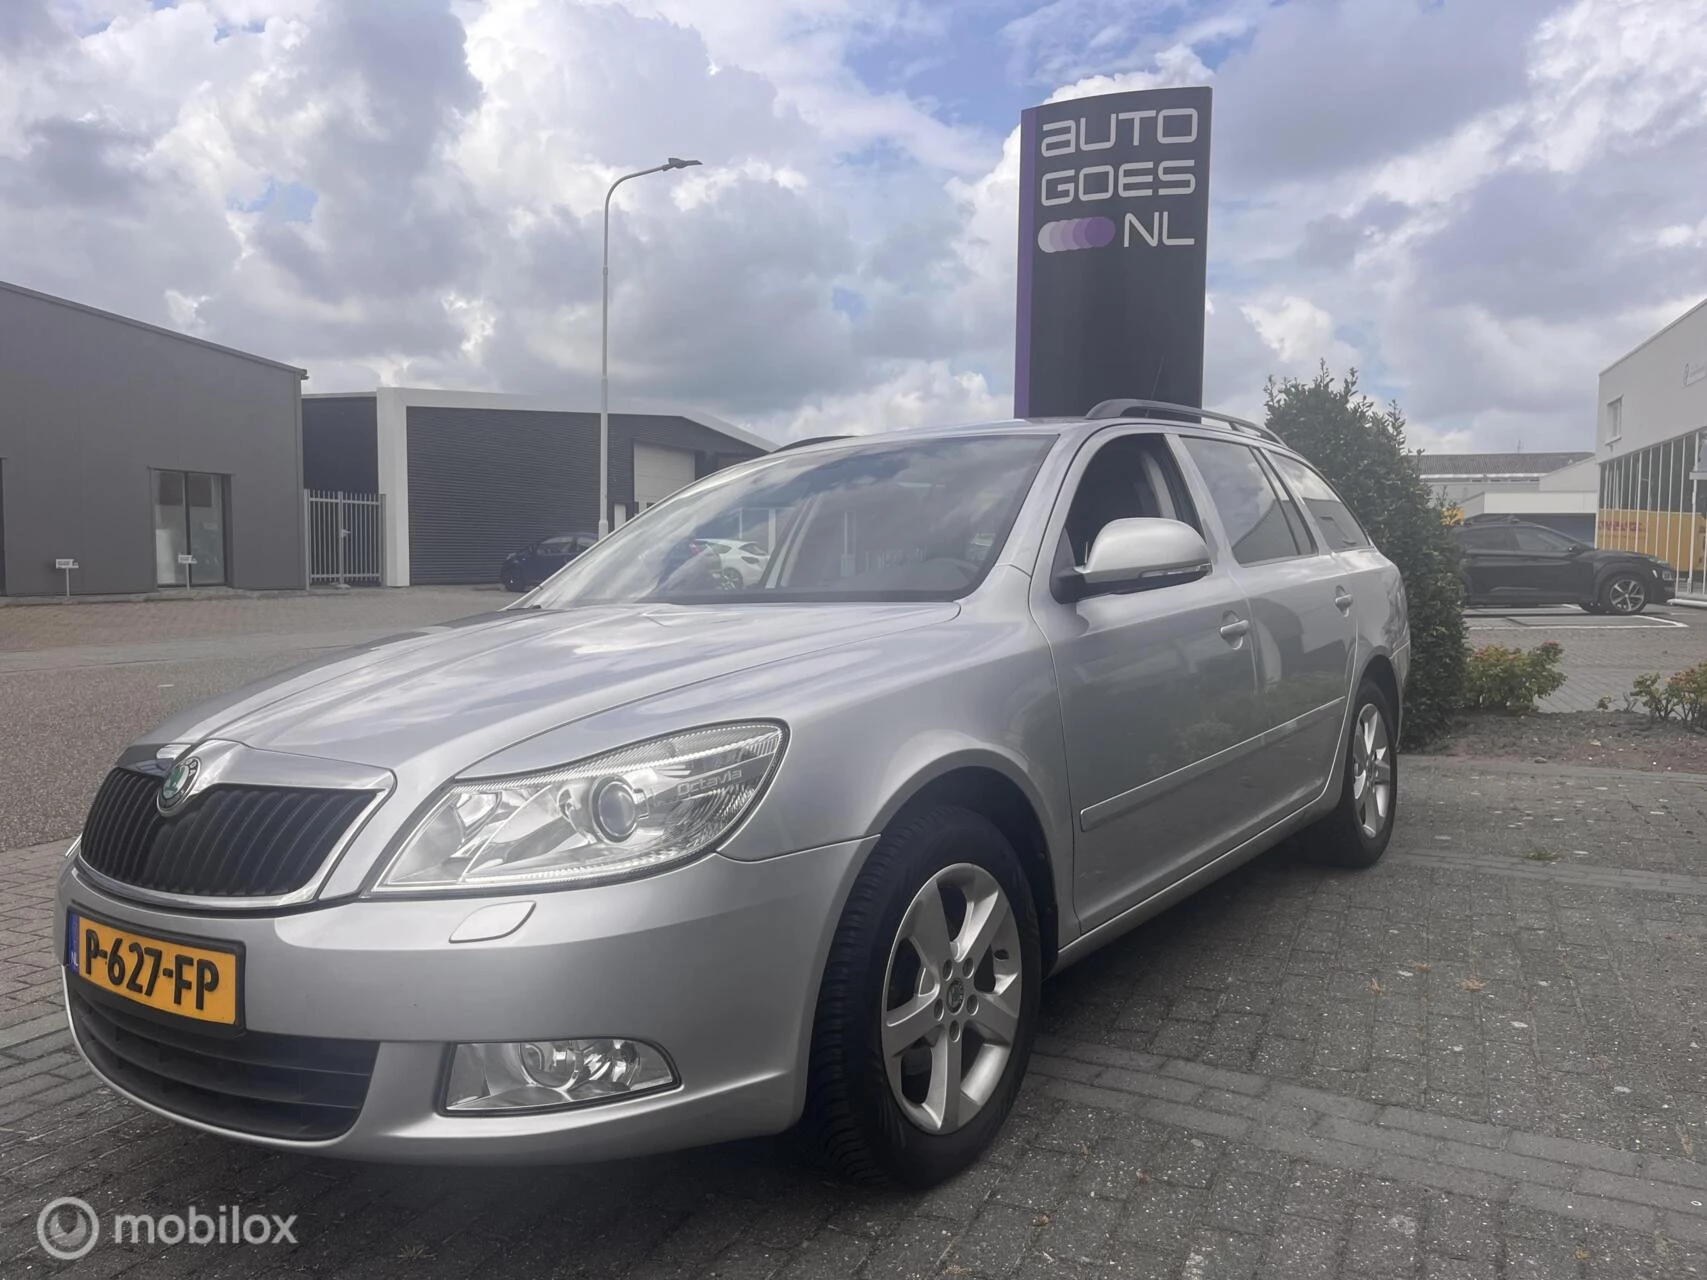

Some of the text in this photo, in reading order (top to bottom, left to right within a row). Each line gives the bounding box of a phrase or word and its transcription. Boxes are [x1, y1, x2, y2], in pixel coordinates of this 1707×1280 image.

[1041, 159, 1196, 206] GOES
[1123, 211, 1195, 248] NL
[85, 928, 220, 1010] P-627-FP
